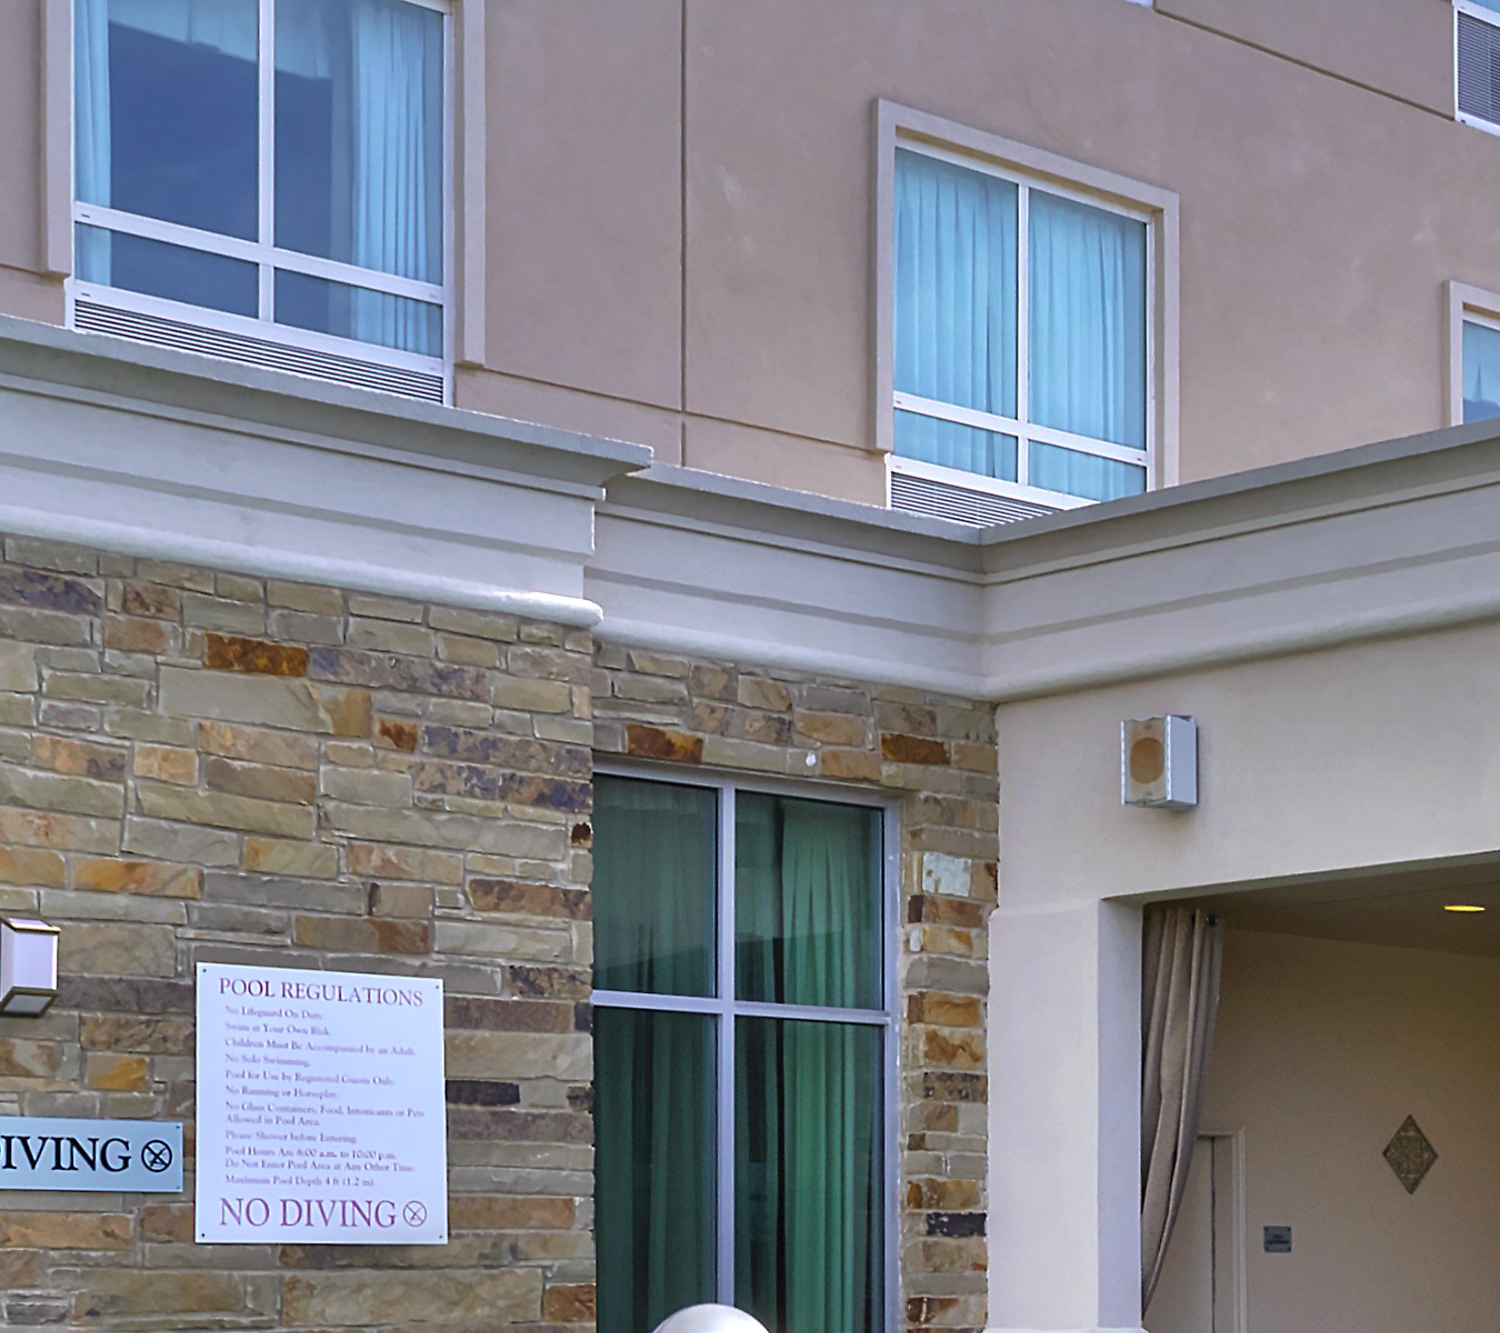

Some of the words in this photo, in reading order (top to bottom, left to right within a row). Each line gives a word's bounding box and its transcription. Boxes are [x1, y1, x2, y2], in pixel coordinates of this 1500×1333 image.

[219, 977, 275, 998] POOL
[281, 981, 423, 1006] REGULATIONS
[226, 1006, 239, 1014] No
[241, 1006, 282, 1018] Lifeguard
[263, 1024, 284, 1033] Your
[287, 1025, 308, 1034] Own
[226, 1039, 263, 1048] Children
[291, 1042, 302, 1050] Be
[226, 1054, 239, 1062] No
[226, 1070, 245, 1079] Pool
[263, 1071, 278, 1080] Use
[281, 1071, 291, 1081] by
[226, 1085, 239, 1094] No
[226, 1101, 239, 1110] No
[226, 1115, 261, 1123] Allowed
[276, 1116, 294, 1125] Pool
[226, 1131, 252, 1139] Please
[255, 1131, 287, 1140] Shower
[290, 1132, 317, 1141] before
[226, 1147, 245, 1155] Pool
[248, 1147, 275, 1156] Hours
[278, 1148, 293, 1156] Are
[226, 1159, 239, 1168] Do
[242, 1159, 258, 1168] Not
[261, 1160, 284, 1169] Enter
[288, 1161, 307, 1169] Pool
[310, 1162, 330, 1170] Area
[344, 1163, 361, 1171] Any
[364, 1163, 389, 1171] Other
[225, 1176, 270, 1184] Maximum
[273, 1176, 292, 1185] Pool
[296, 1176, 322, 1187] Depth
[325, 1177, 330, 1185] 4
[219, 1198, 270, 1227] NO
[280, 1199, 397, 1228] DIVING
